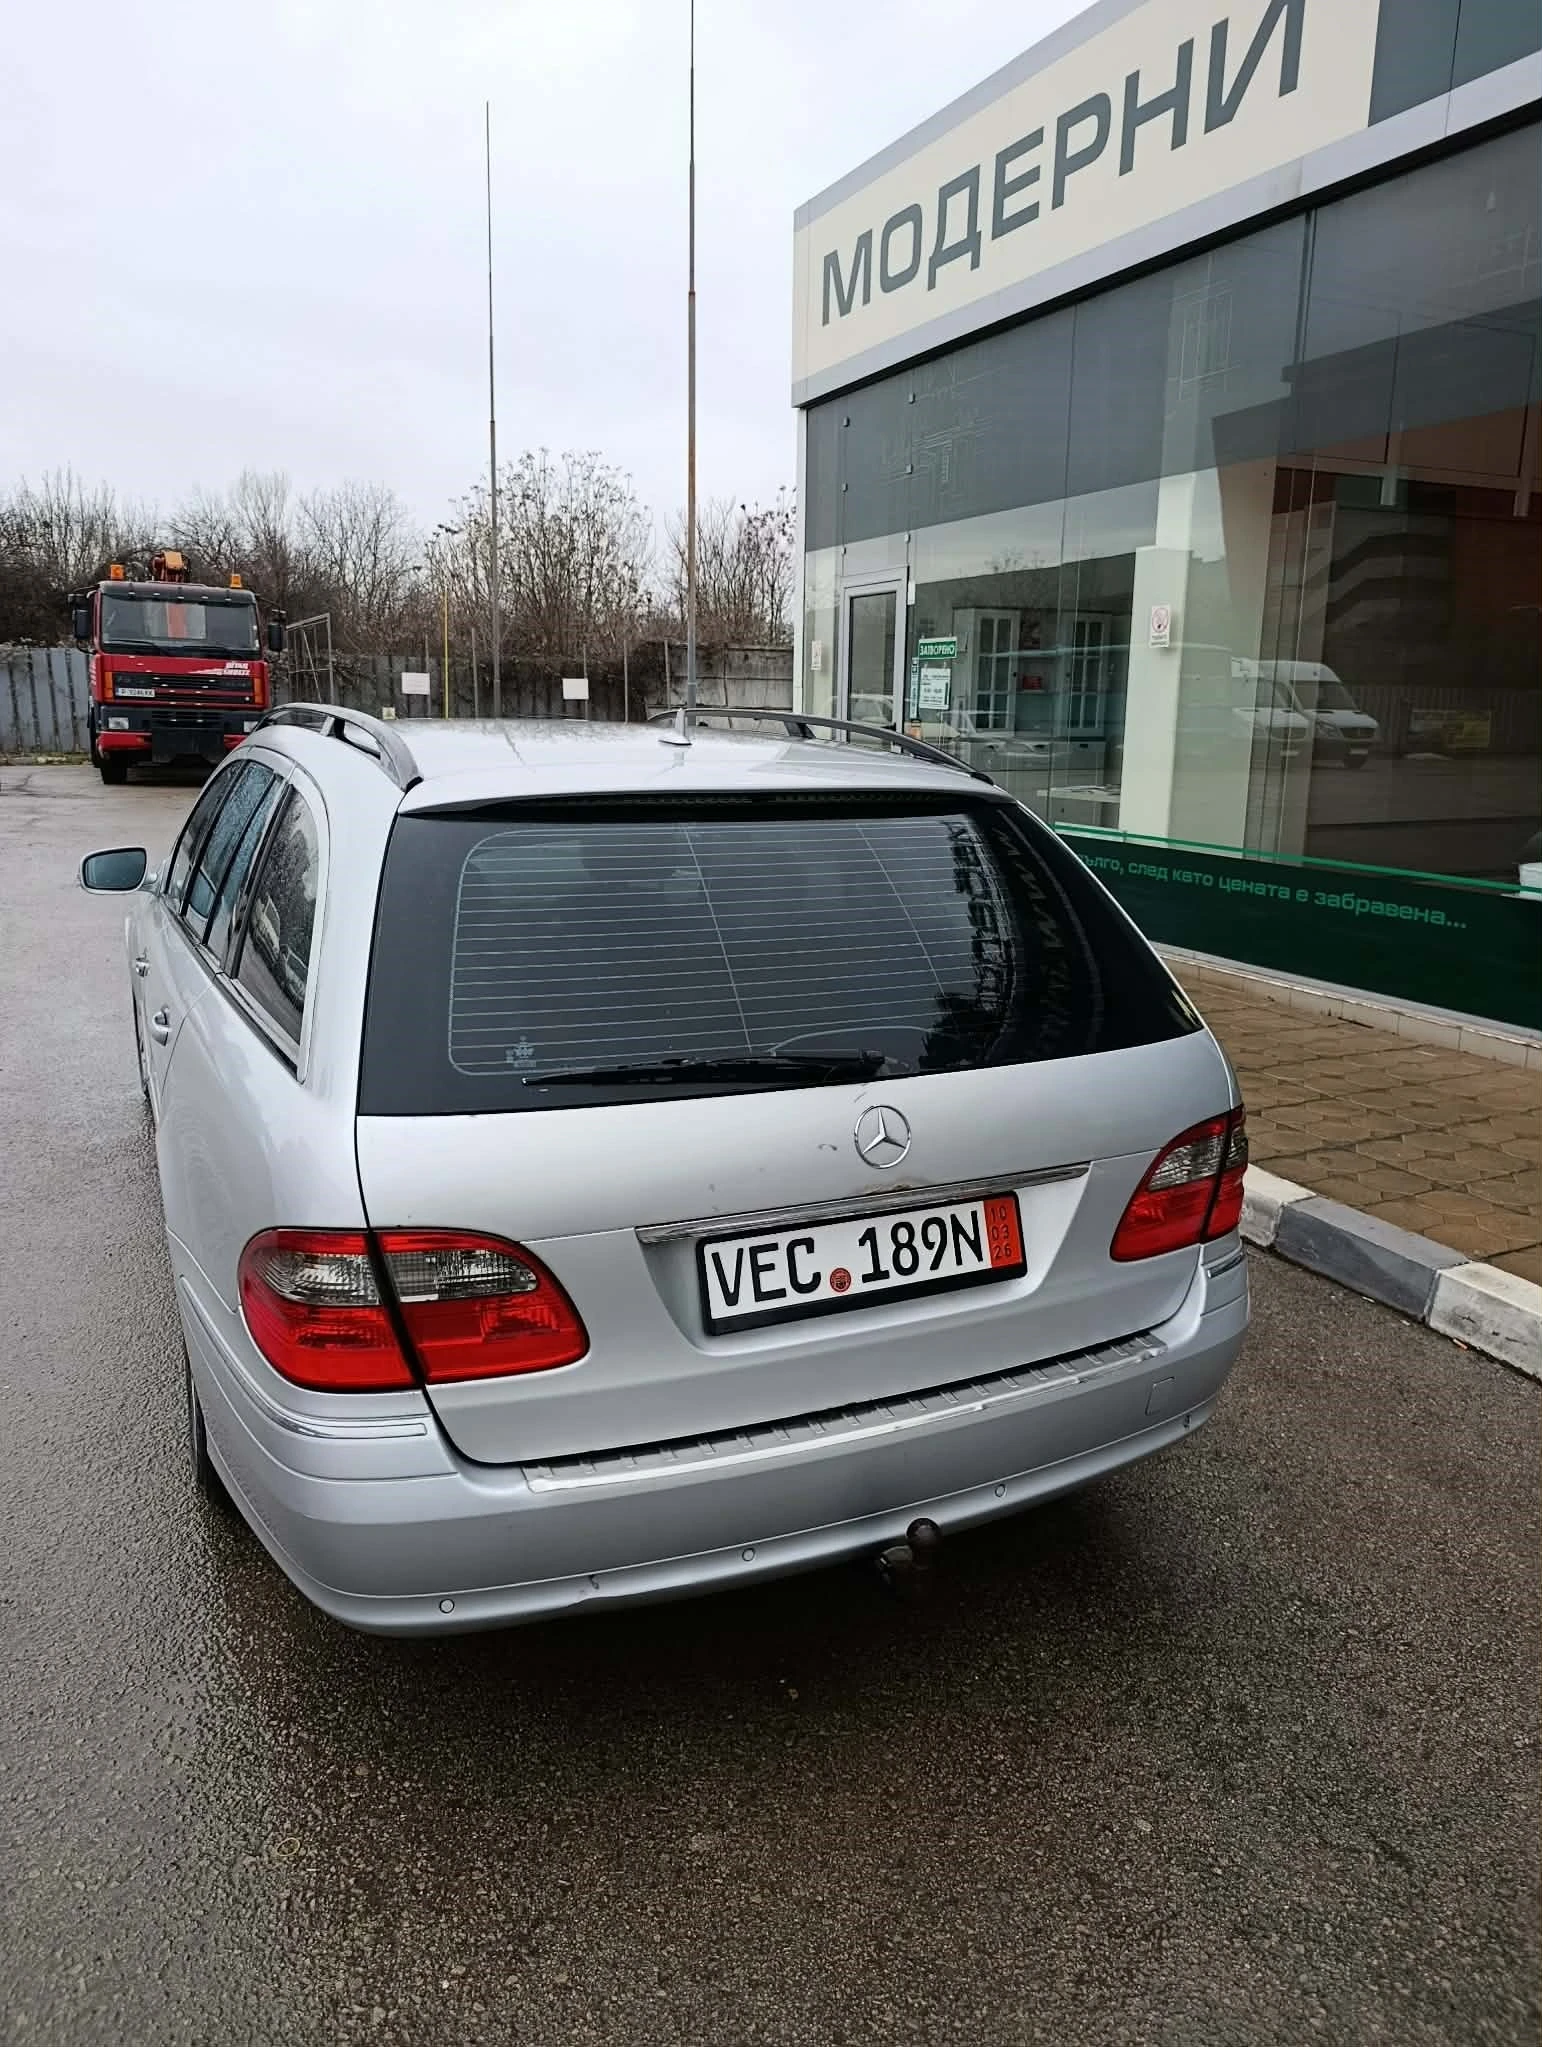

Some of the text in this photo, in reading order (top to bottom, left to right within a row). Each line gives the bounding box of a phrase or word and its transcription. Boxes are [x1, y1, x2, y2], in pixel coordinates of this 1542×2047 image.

[822, 0, 1306, 327] МОДЕРНИ
[1128, 862, 1169, 882] след
[1172, 868, 1214, 887] като
[1218, 877, 1291, 899] цената
[1295, 889, 1309, 902] е
[1314, 892, 1467, 929] забравена...
[990, 1206, 1007, 1222] 10
[991, 1224, 1010, 1241] 03
[711, 1210, 984, 1307] VEC 189N
[993, 1243, 1012, 1260] 26
